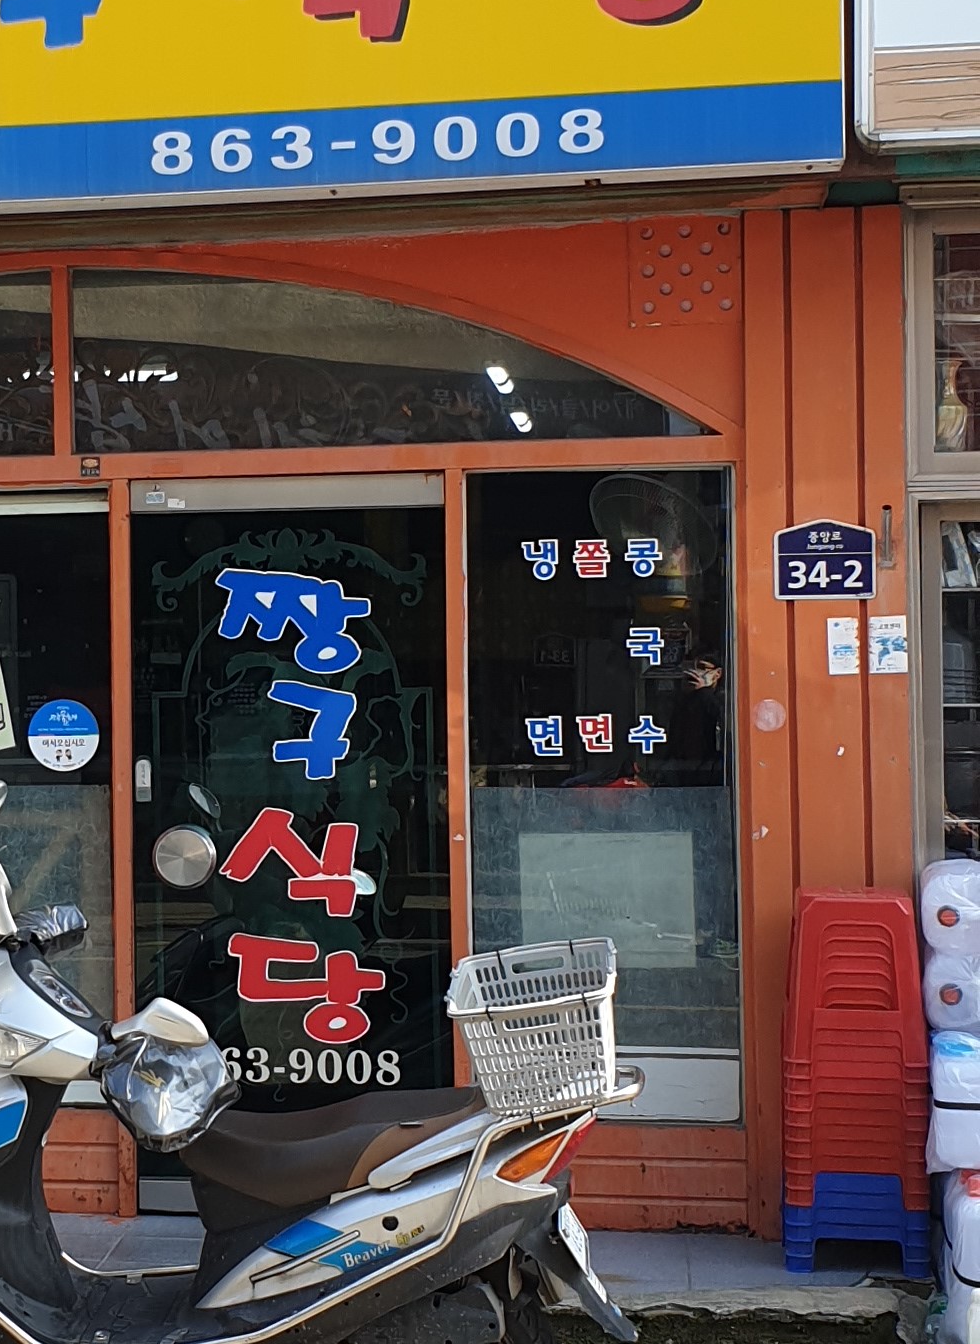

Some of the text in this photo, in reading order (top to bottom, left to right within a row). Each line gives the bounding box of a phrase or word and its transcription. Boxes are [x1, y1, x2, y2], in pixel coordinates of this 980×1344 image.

[151, 108, 606, 176] 863-9008
[808, 531, 842, 544] 중앙로
[787, 559, 863, 589] 34-2
[521, 538, 563, 757] 냉면
[572, 539, 613, 753] 쫄면
[624, 537, 667, 754] 콩국수
[219, 1046, 401, 1086] 63-9008
[340, 1239, 391, 1268] Beaver
